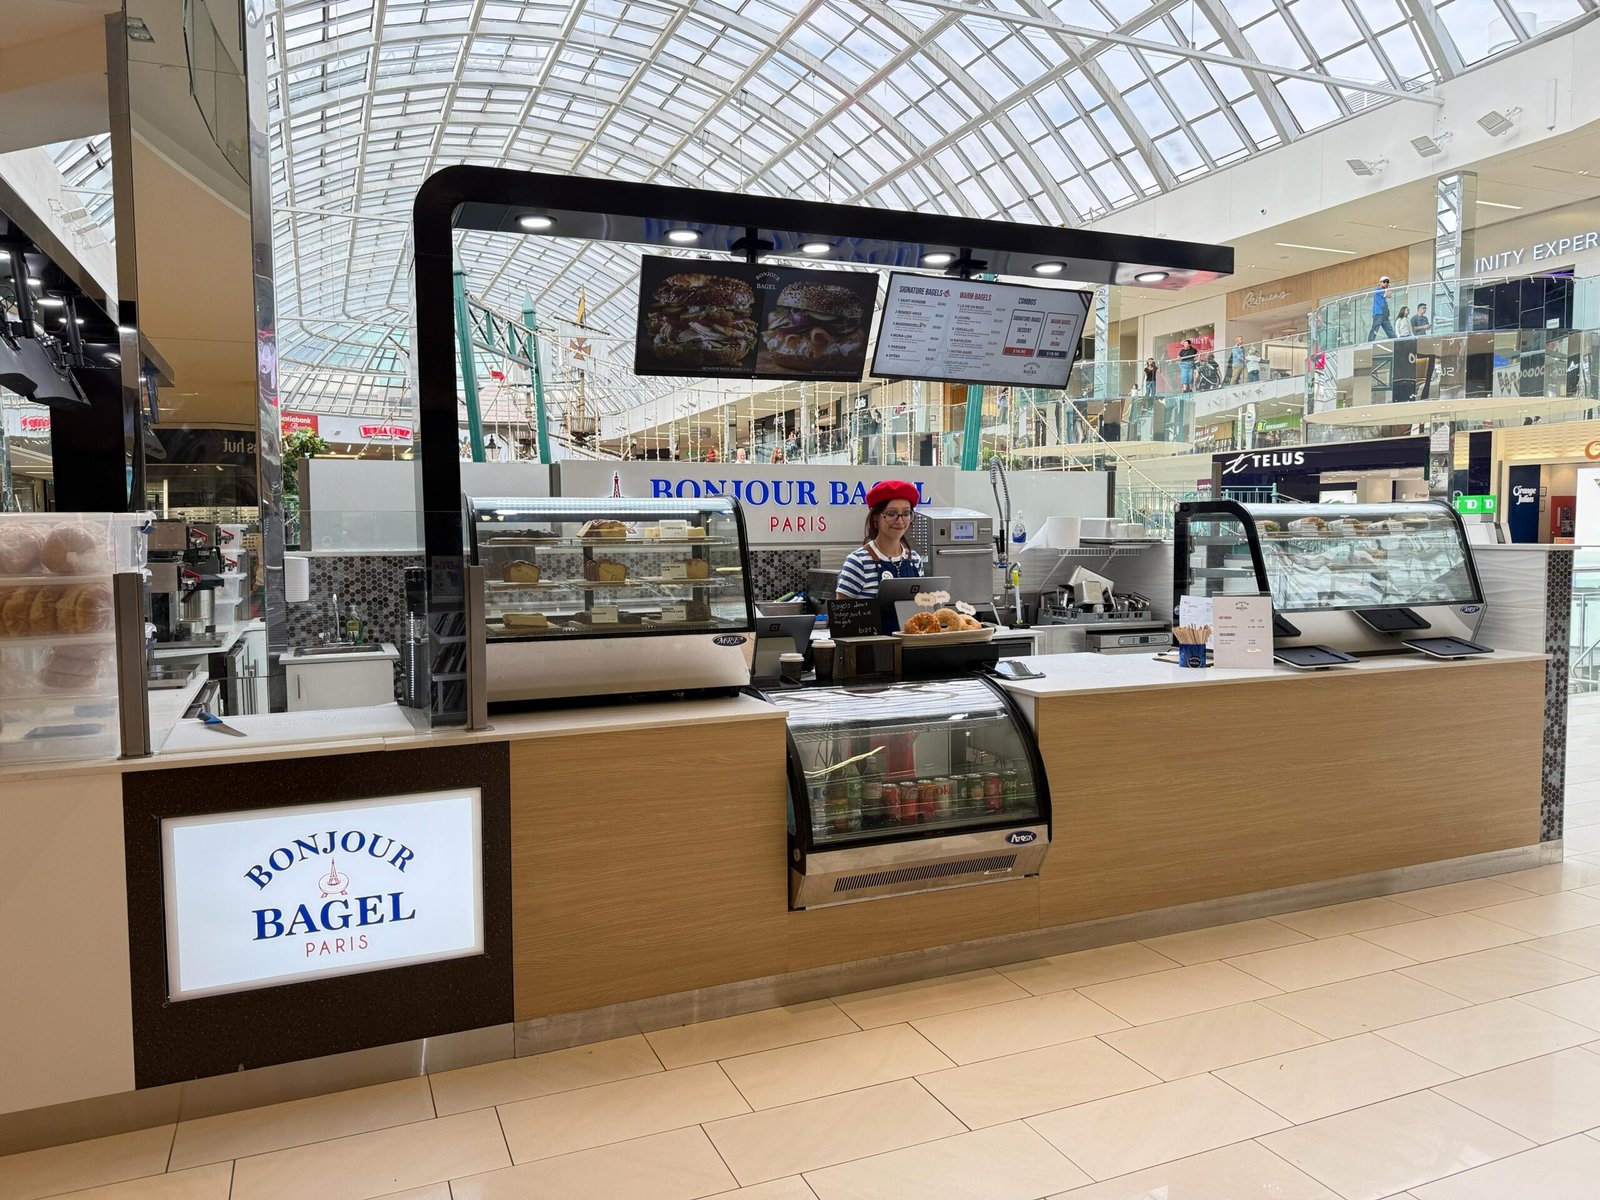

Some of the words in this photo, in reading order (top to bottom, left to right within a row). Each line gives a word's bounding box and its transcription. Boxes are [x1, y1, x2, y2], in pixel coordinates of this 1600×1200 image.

[755, 271, 780, 283] BONJOUR
[898, 285, 924, 294] SIGNATURE
[924, 288, 943, 296] BAGELS
[959, 291, 974, 299] WARM
[974, 293, 992, 301] BAGELS
[1017, 297, 1037, 305] COMBOS
[1252, 451, 1305, 467] TELUS
[650, 479, 819, 506] BONJOUR
[828, 479, 932, 506] BAL
[770, 515, 827, 532] PARIS
[243, 830, 415, 890] BONJOUR
[252, 891, 416, 941] BAGEL
[305, 934, 369, 958] PARIS
